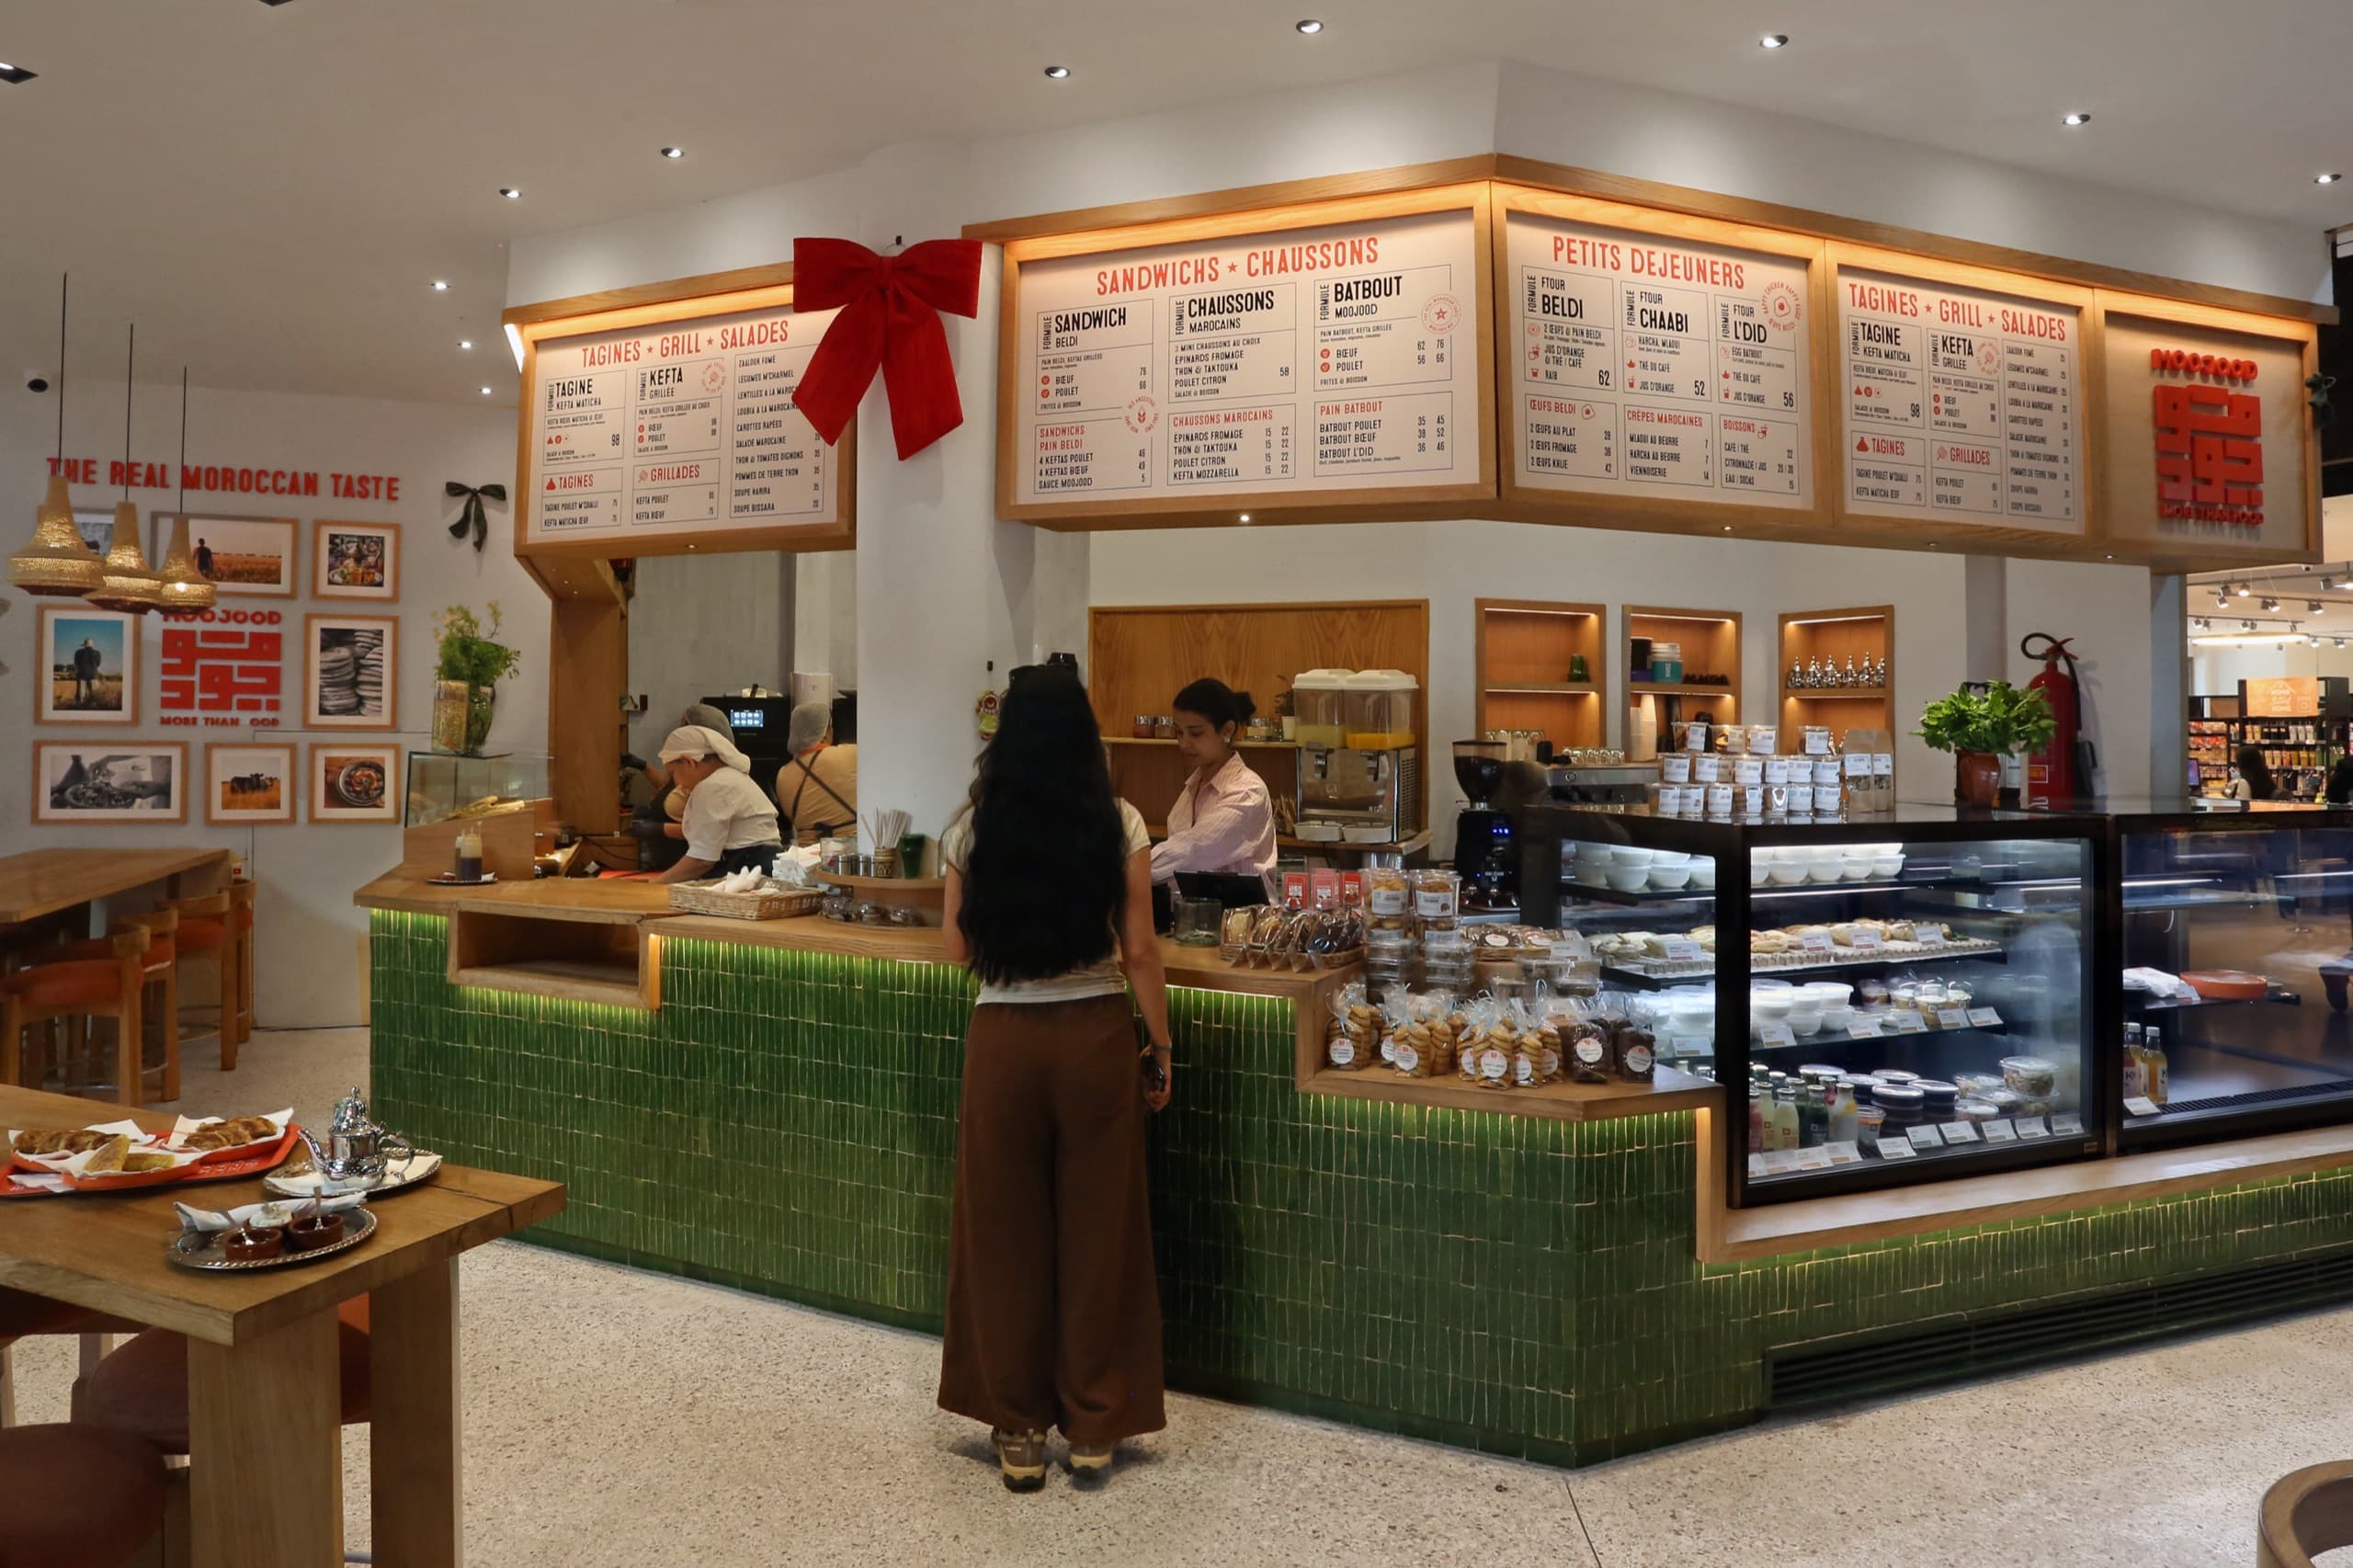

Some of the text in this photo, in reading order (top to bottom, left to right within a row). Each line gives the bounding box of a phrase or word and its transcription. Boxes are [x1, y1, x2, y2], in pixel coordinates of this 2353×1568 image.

[1097, 236, 1379, 296] SANDWICHS CHAUSSONS
[1552, 234, 1745, 290] PETITS DEJEUNERS
[1334, 275, 1403, 303] BATBOUT
[1541, 276, 1565, 291] FTOUR
[1320, 283, 1330, 321] FORMULE
[1527, 274, 1537, 313] FORMULE
[1639, 290, 1664, 305] FTOUR
[1188, 290, 1275, 318] CHAUSSONS
[1335, 302, 1379, 319] MOOJOOD
[1541, 293, 1584, 320] BELDI
[1626, 290, 1636, 326] FORMULE
[1733, 304, 1755, 317] FTOUR
[1848, 283, 2066, 342] TAGINES GRILL SALADES
[1054, 306, 1126, 334] SANDWICH
[1175, 300, 1185, 335] FORMULE
[1189, 317, 1241, 334] MAROCAINS
[1640, 308, 1688, 334] CHAABI
[1721, 301, 1730, 338] FORMULE
[1042, 315, 1052, 350] FORMULE
[1733, 320, 1768, 344] L'DID
[1851, 321, 1860, 356] FORMULE
[1860, 322, 1901, 347] TAGINE
[582, 319, 789, 369] TAGINES GRILL SALADES
[1055, 335, 1078, 348] BELDI
[1196, 340, 1231, 351] CHAUSSONS
[1233, 338, 1241, 347] AU
[1242, 337, 1261, 347] CHOIX
[1931, 333, 1939, 367] FORMULE
[1941, 335, 1974, 358] KEFTA
[1211, 349, 1245, 361] FROMAGE
[1336, 347, 1358, 358] BŒUF
[1732, 347, 1742, 357] EGG
[1863, 346, 1911, 363] KEFTA MATICHA
[1175, 366, 1193, 376] THON
[1204, 362, 1239, 374] TAKTOUKA
[1336, 360, 1364, 372] POULET
[649, 367, 684, 387] KEFTA
[1055, 375, 1074, 385] BŒUF
[1175, 375, 1227, 388] POULET CITRON
[1320, 375, 1369, 386] FRITES BOISSON
[1598, 369, 1610, 386] 62
[555, 379, 594, 398] TAGINE
[1055, 386, 1079, 397] POULET
[1694, 380, 1706, 396] 52
[556, 398, 574, 411] KEFTA
[1529, 399, 1576, 415] ŒUFS BELDI
[1783, 392, 1794, 407] 56
[1320, 401, 1383, 416] PAIN BATBOUT
[1910, 403, 1920, 418] 98
[1173, 409, 1273, 427] CHAUSSONS MAROCAINS
[1319, 421, 1352, 433] BATBOUT
[1354, 419, 1382, 431] POULET
[1417, 415, 1427, 426] 35
[1657, 414, 1703, 427] MAROCAINES
[1723, 419, 1756, 433] BOISSONS
[1040, 425, 1086, 438] SANDWICHS
[1211, 426, 1290, 440] FROMAGE 15 22
[1319, 426, 1445, 446] BATBOUT BŒUF 52
[1529, 423, 1576, 437] 2 ŒUFS AU PLAT
[1040, 438, 1083, 451] PAIN BELDI
[1174, 438, 1290, 456] THON TAKTOUKA 15 22
[1530, 439, 1534, 449] 2
[1552, 442, 1577, 454] FROMAGE
[1657, 436, 1679, 447] BEURRE
[1871, 437, 1905, 457] TAGINES
[1045, 452, 1094, 464] KEFTAS POULET
[1173, 451, 1289, 469] POULET CITRON 15 22
[1319, 448, 1351, 460] BATBOUT
[1353, 446, 1374, 458] L'DID
[1660, 451, 1681, 462] BEURRE
[1949, 447, 1991, 466] GRILLADES
[1045, 465, 1089, 477] KEFTAS BŒUF
[1530, 457, 1552, 468] 2 ŒUFS
[47, 458, 400, 501] THE REAL MOROCCAN TASTE
[650, 464, 700, 483] GRILLADES
[1173, 464, 1289, 481] KEFTA MOZZARELLA 15 22
[1630, 465, 1667, 478] VIENNOISERIE
[558, 473, 595, 490] TAGINES
[1039, 477, 1093, 490] SAUCE MOOJOOD
[160, 716, 198, 726] MORE
[202, 717, 239, 727] THAN
